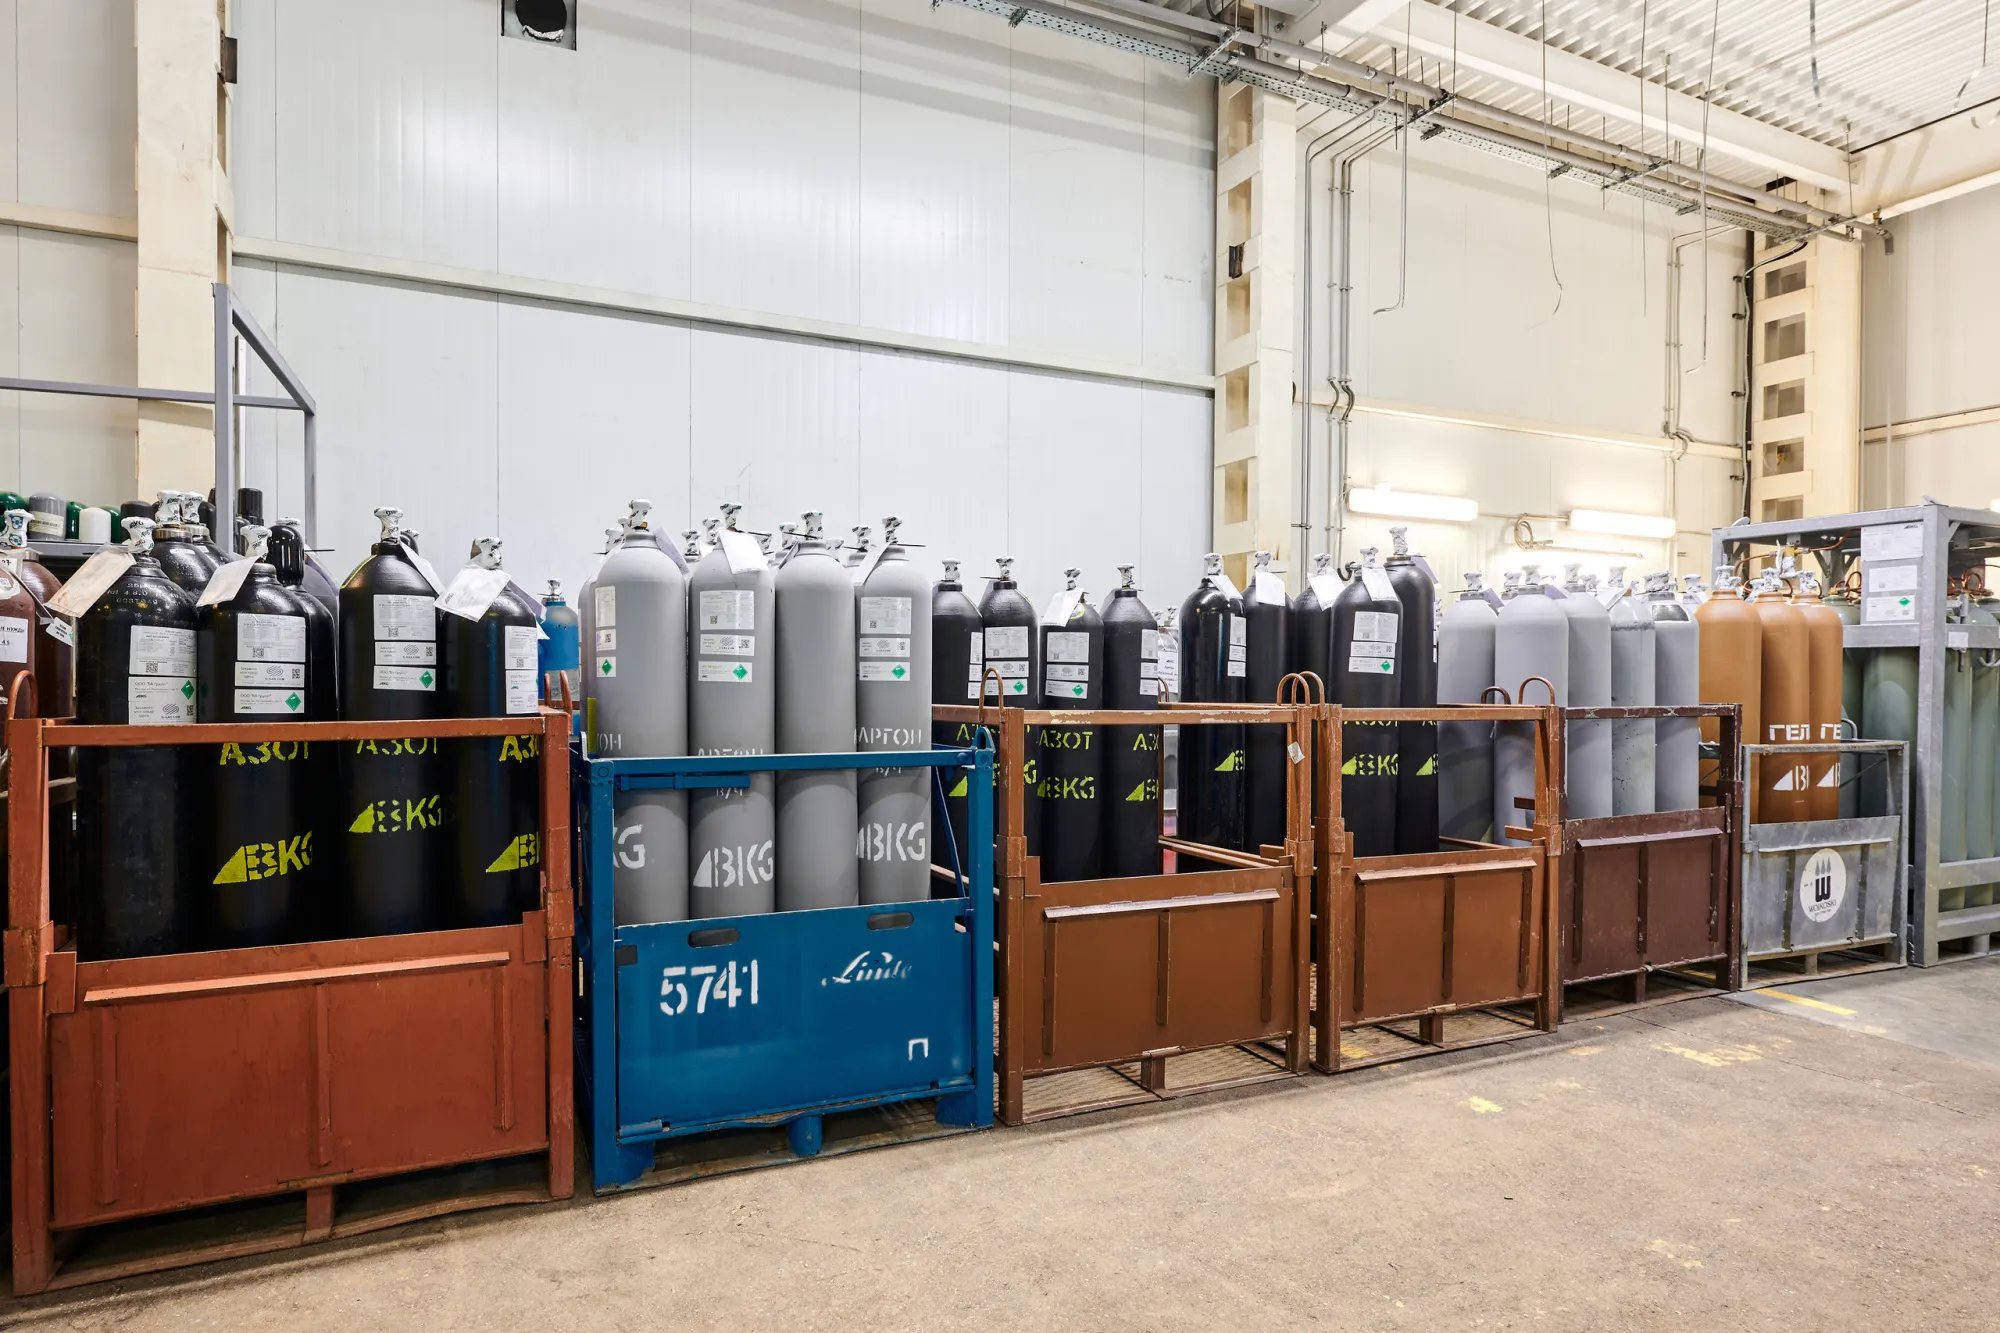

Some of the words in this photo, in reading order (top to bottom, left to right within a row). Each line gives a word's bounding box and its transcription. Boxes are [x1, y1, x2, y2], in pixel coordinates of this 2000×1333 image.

[857, 726, 922, 746] АРГОН
[1039, 730, 1094, 750] АЗОТ
[1769, 724, 1810, 741] ГЕЛ
[1047, 776, 1095, 800] BKG
[867, 821, 926, 862] BKG
[714, 839, 774, 888] BKG
[659, 959, 758, 1016] 5741
